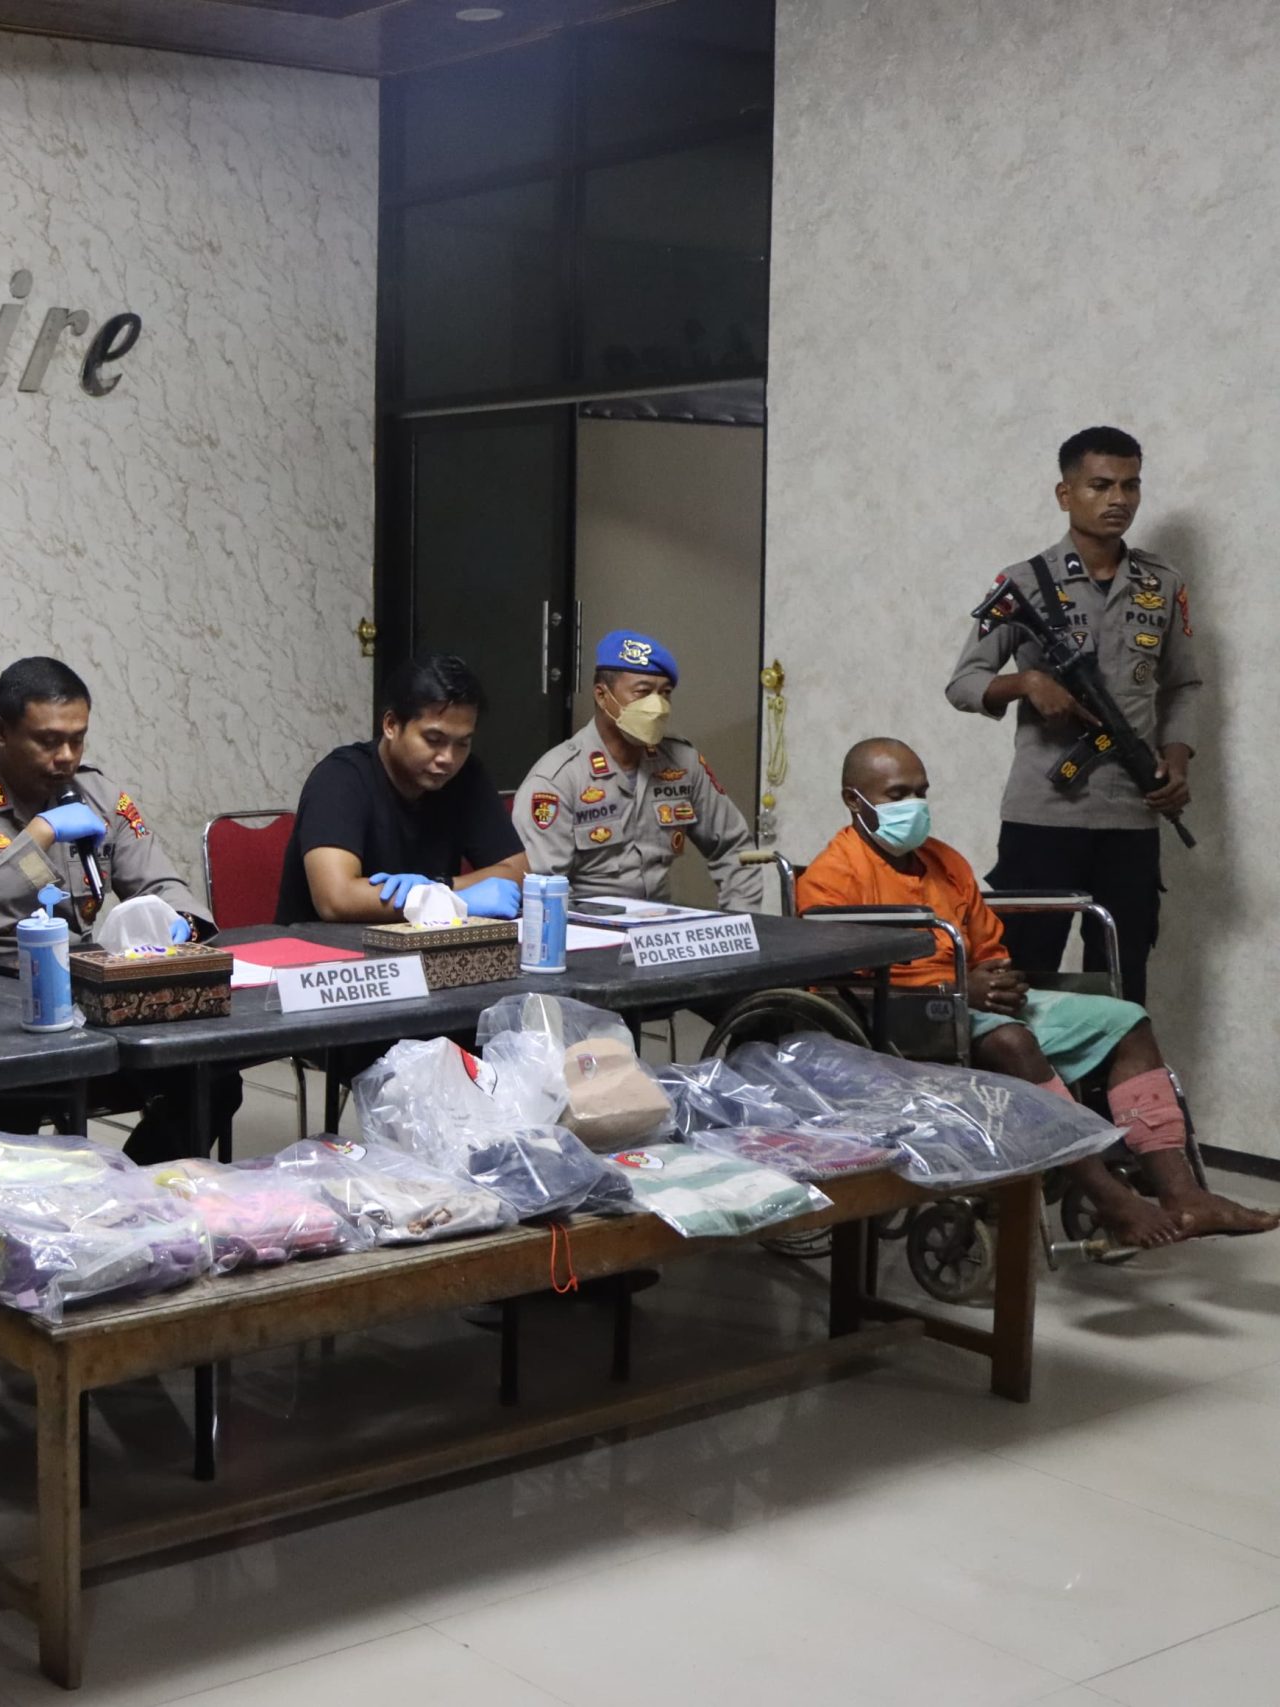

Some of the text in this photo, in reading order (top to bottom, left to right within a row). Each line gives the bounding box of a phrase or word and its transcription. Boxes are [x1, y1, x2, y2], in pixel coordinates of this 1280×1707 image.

[1095, 734, 1111, 751] 08
[1061, 761, 1077, 778] 08
[653, 784, 691, 799] POLRI
[634, 922, 752, 950] KASAT RESKRIM
[638, 937, 754, 964] POLRES NABIRE
[300, 962, 400, 989] KAPOLRES
[320, 981, 391, 1004] NABIRE
